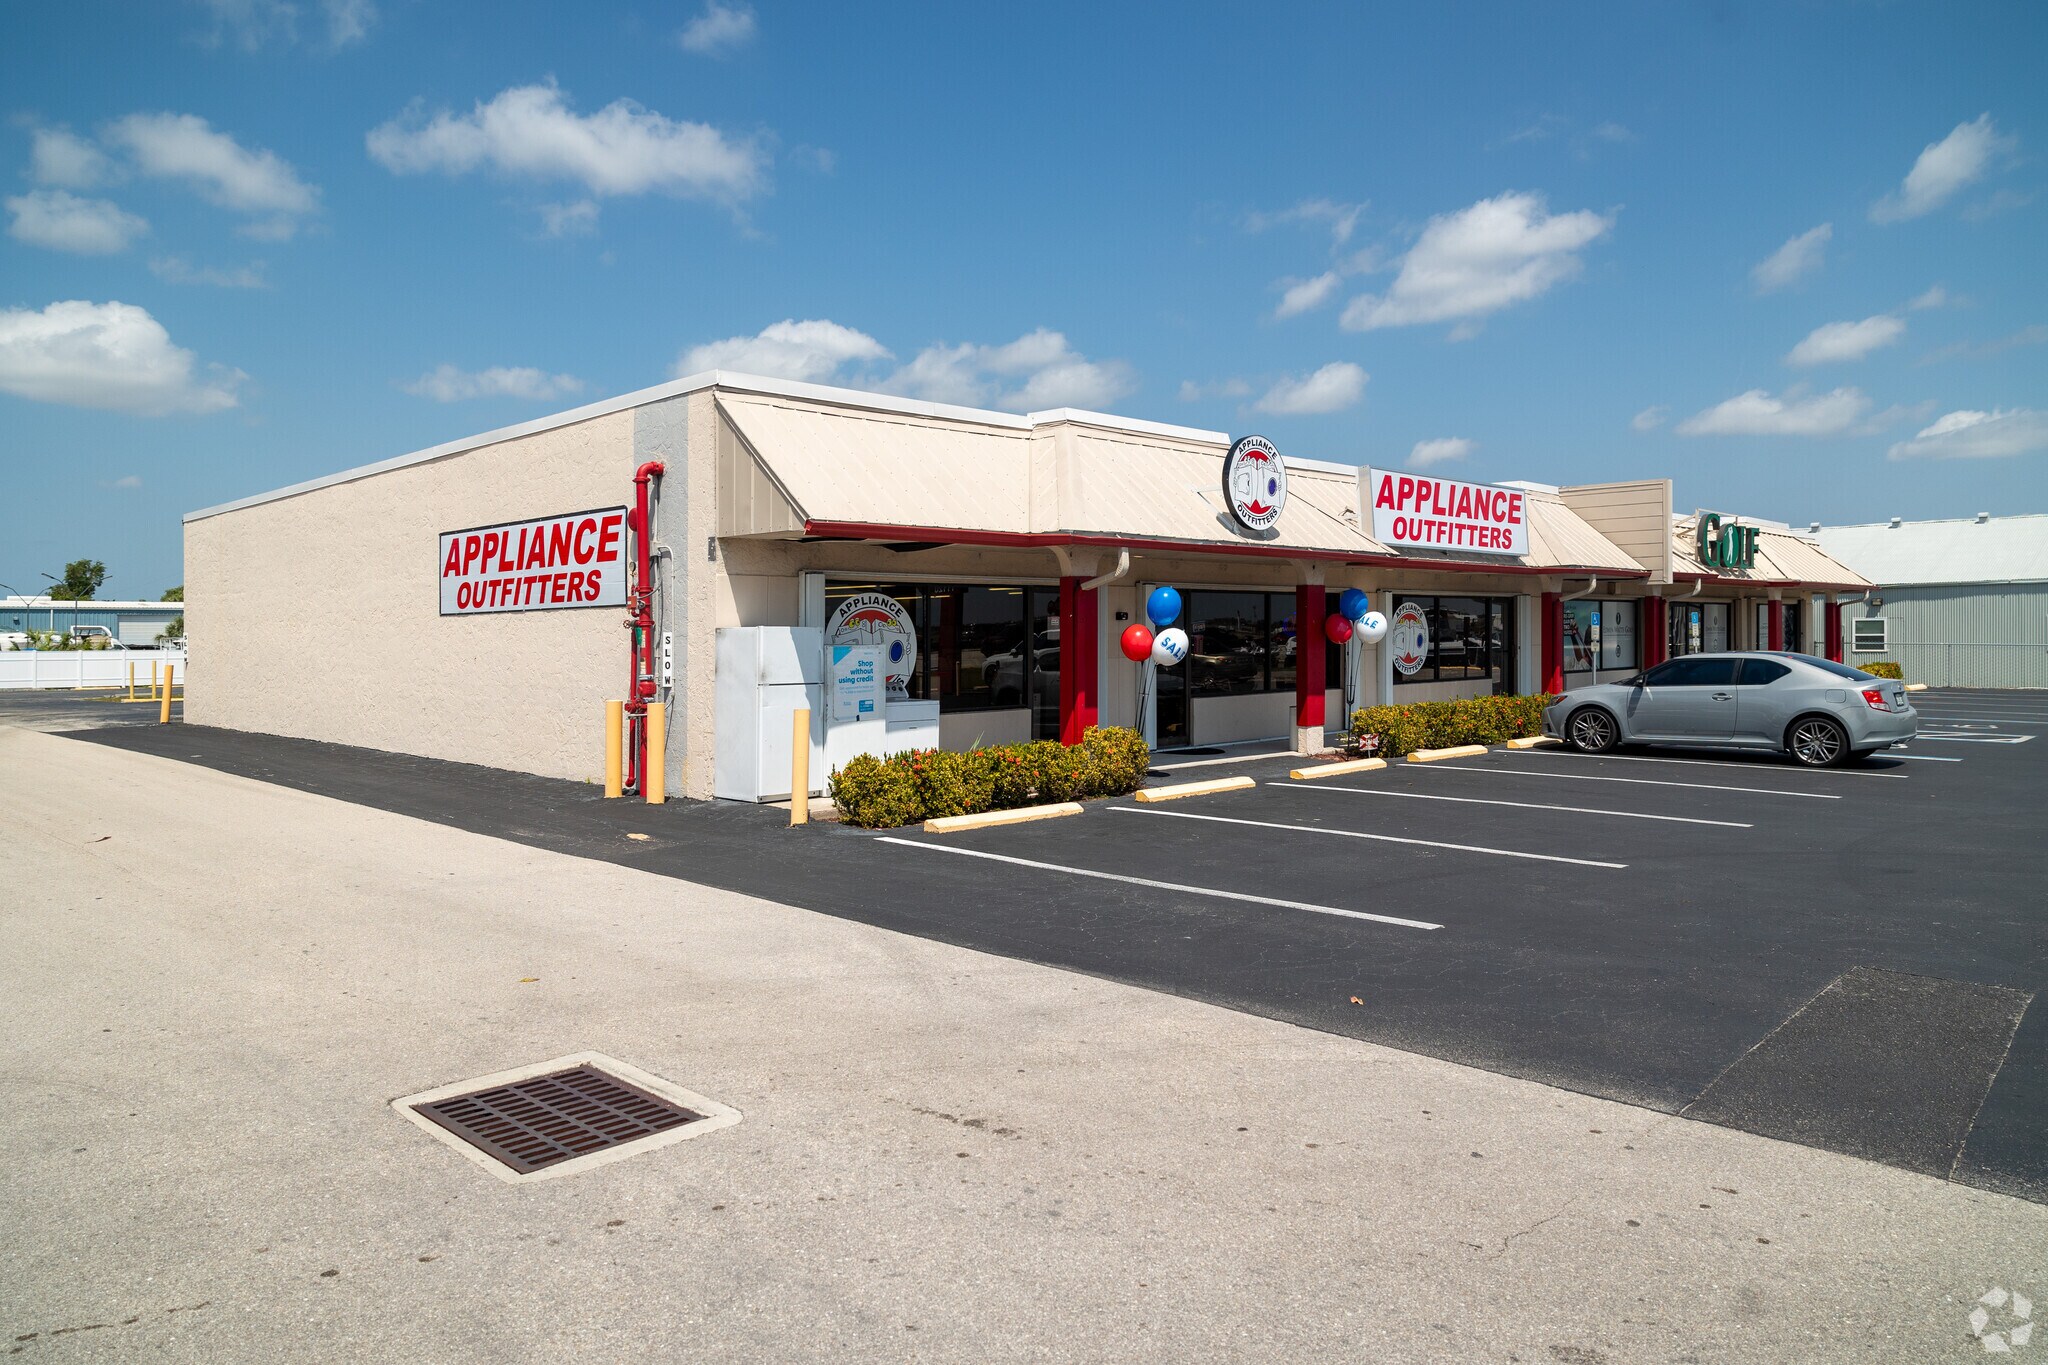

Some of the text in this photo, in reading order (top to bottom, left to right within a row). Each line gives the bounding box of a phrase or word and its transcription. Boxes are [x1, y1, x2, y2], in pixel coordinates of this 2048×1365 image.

[1238, 439, 1278, 460] APPLIANCE
[1375, 474, 1523, 524] APPLIANCE
[1237, 504, 1278, 526] OUTFITTERS
[1392, 516, 1513, 550] OUTFITTERS
[1697, 513, 1759, 569] GOLF
[443, 514, 623, 578] APPLIANCE
[456, 569, 602, 610] OUTFITTERS
[839, 596, 904, 618] APPLIANCE
[1396, 604, 1423, 618] APPLIANCE
[1357, 616, 1379, 630] ALE
[1394, 656, 1424, 674] OUTFITTERS
[856, 675, 874, 683] credit
